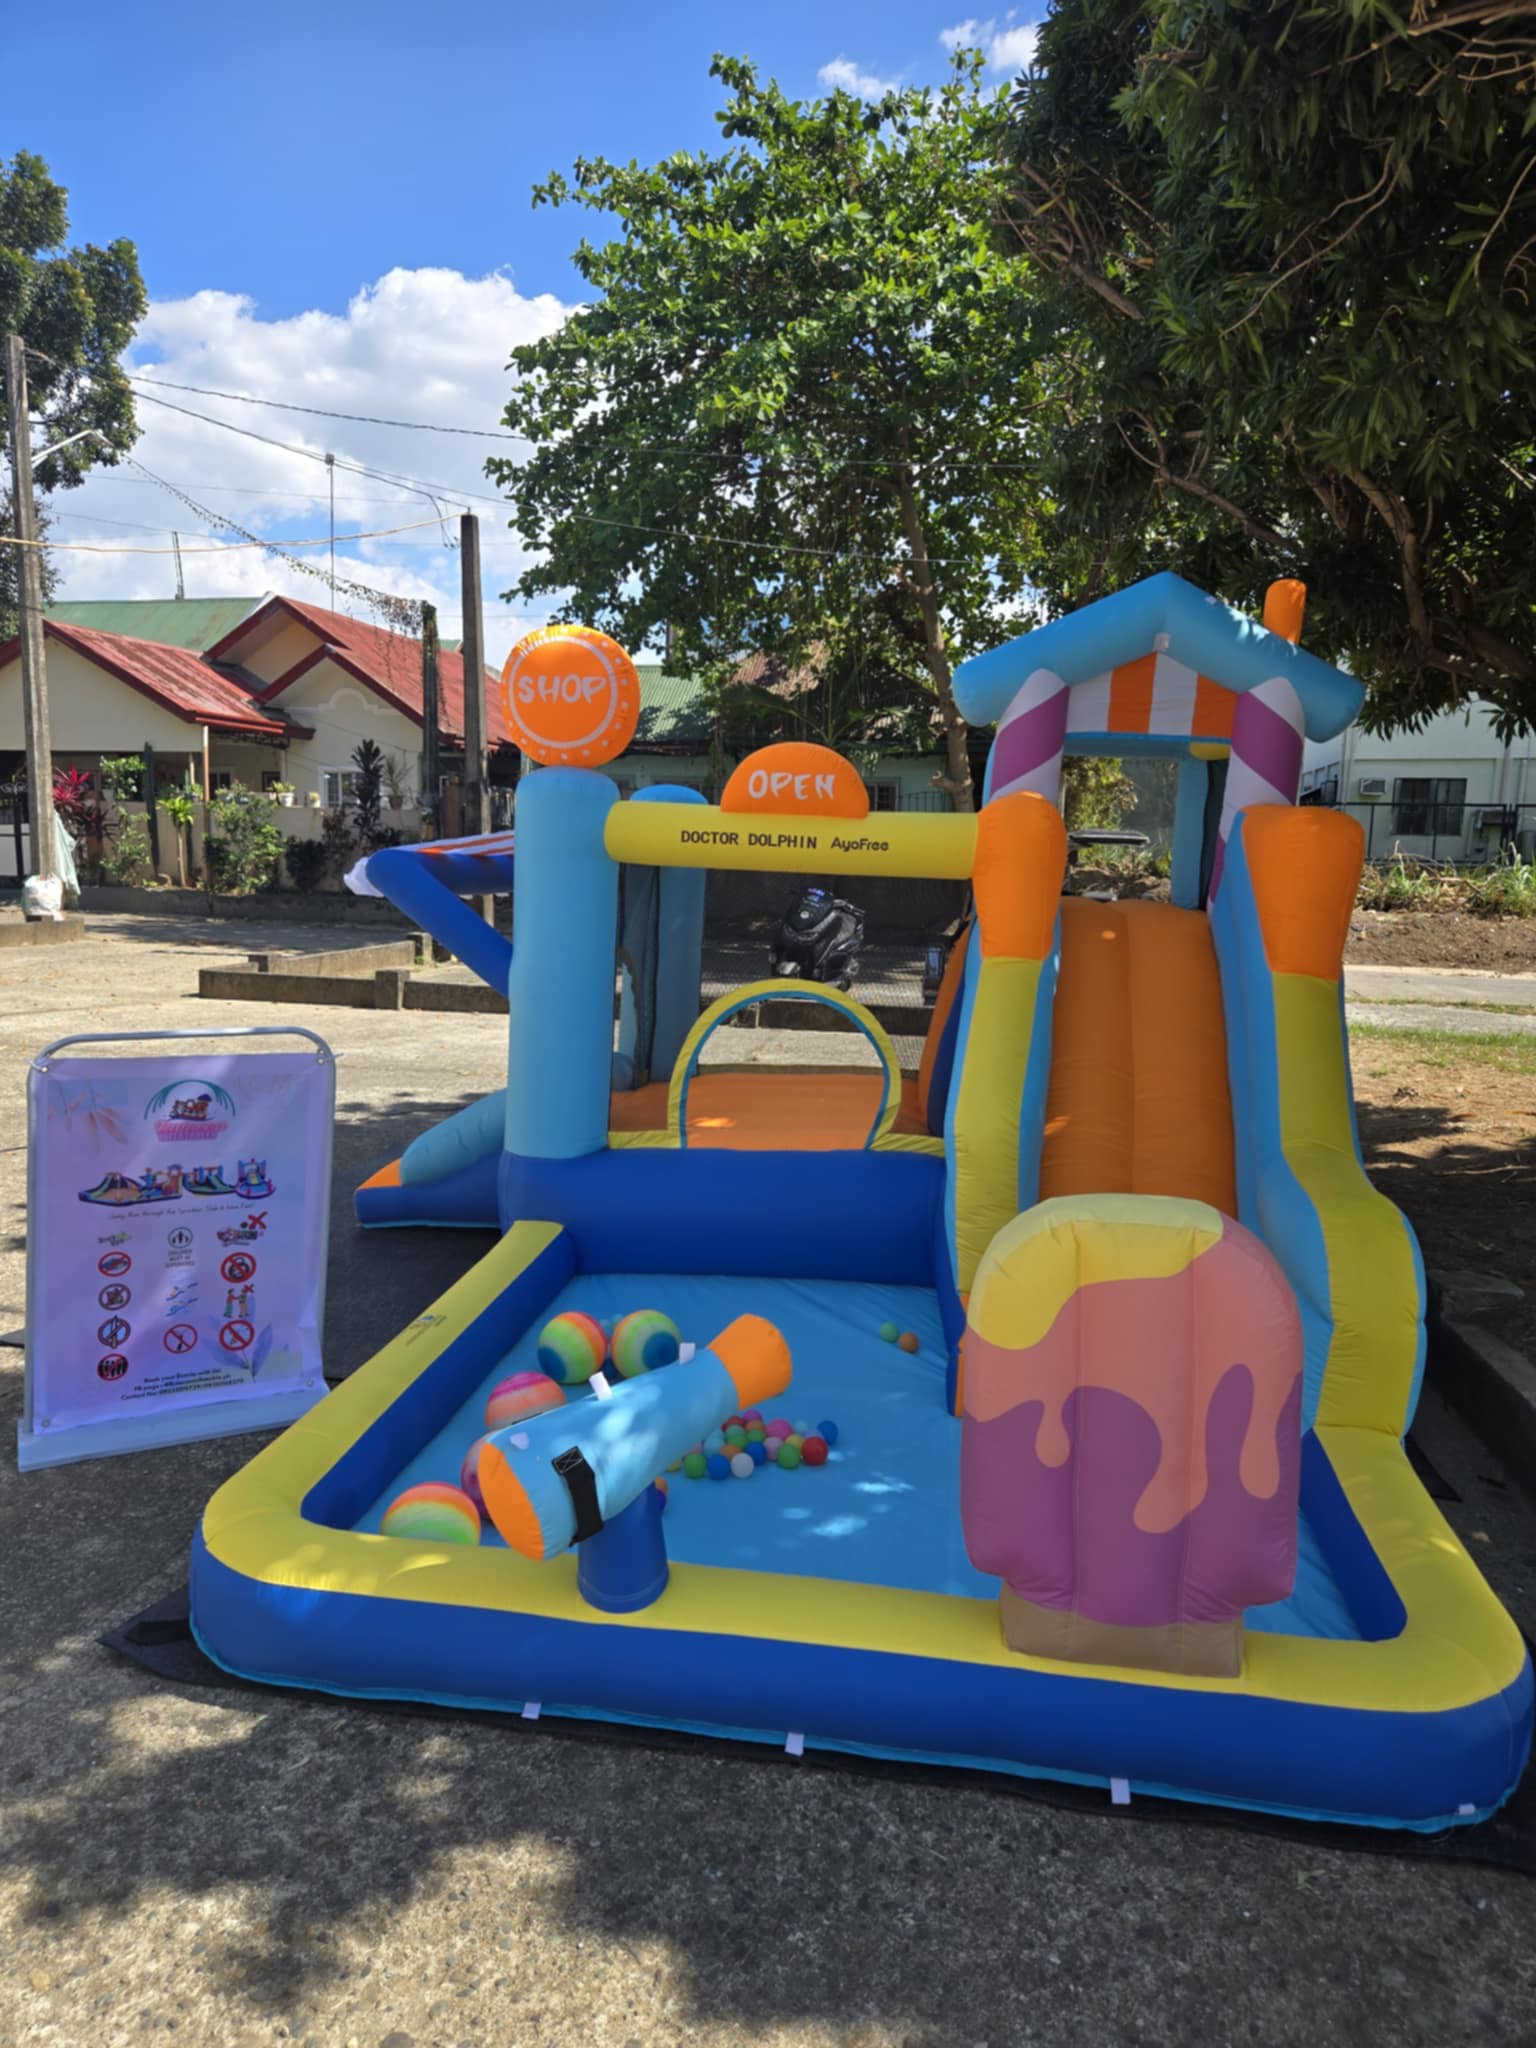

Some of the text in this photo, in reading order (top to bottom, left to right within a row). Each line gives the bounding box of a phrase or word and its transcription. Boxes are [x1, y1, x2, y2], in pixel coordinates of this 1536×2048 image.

[518, 674, 607, 704] SHOP
[748, 769, 835, 800] OPEN
[681, 830, 889, 852] DOCTOR DOLPHIN AyoFree
